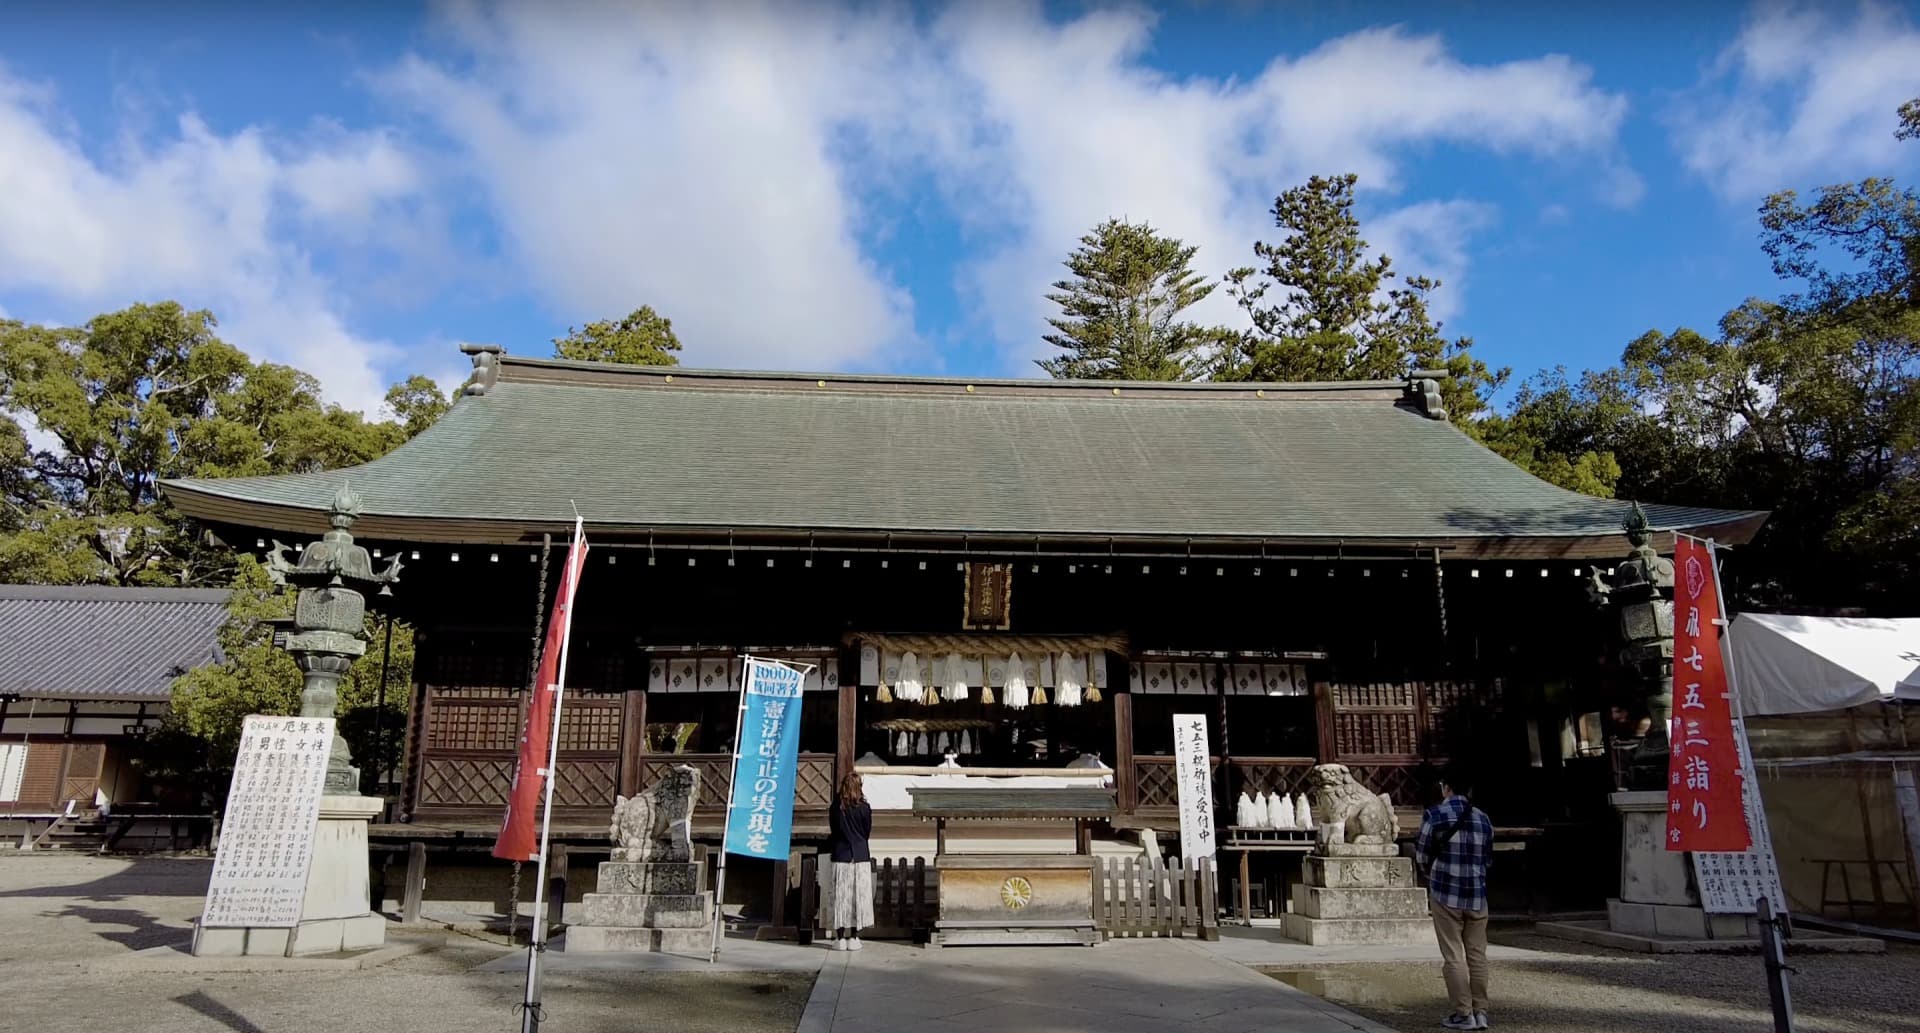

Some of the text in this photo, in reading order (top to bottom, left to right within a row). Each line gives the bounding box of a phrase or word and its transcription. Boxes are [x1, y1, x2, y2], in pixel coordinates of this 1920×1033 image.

[746, 699, 786, 855] 憲法改正の実現を
